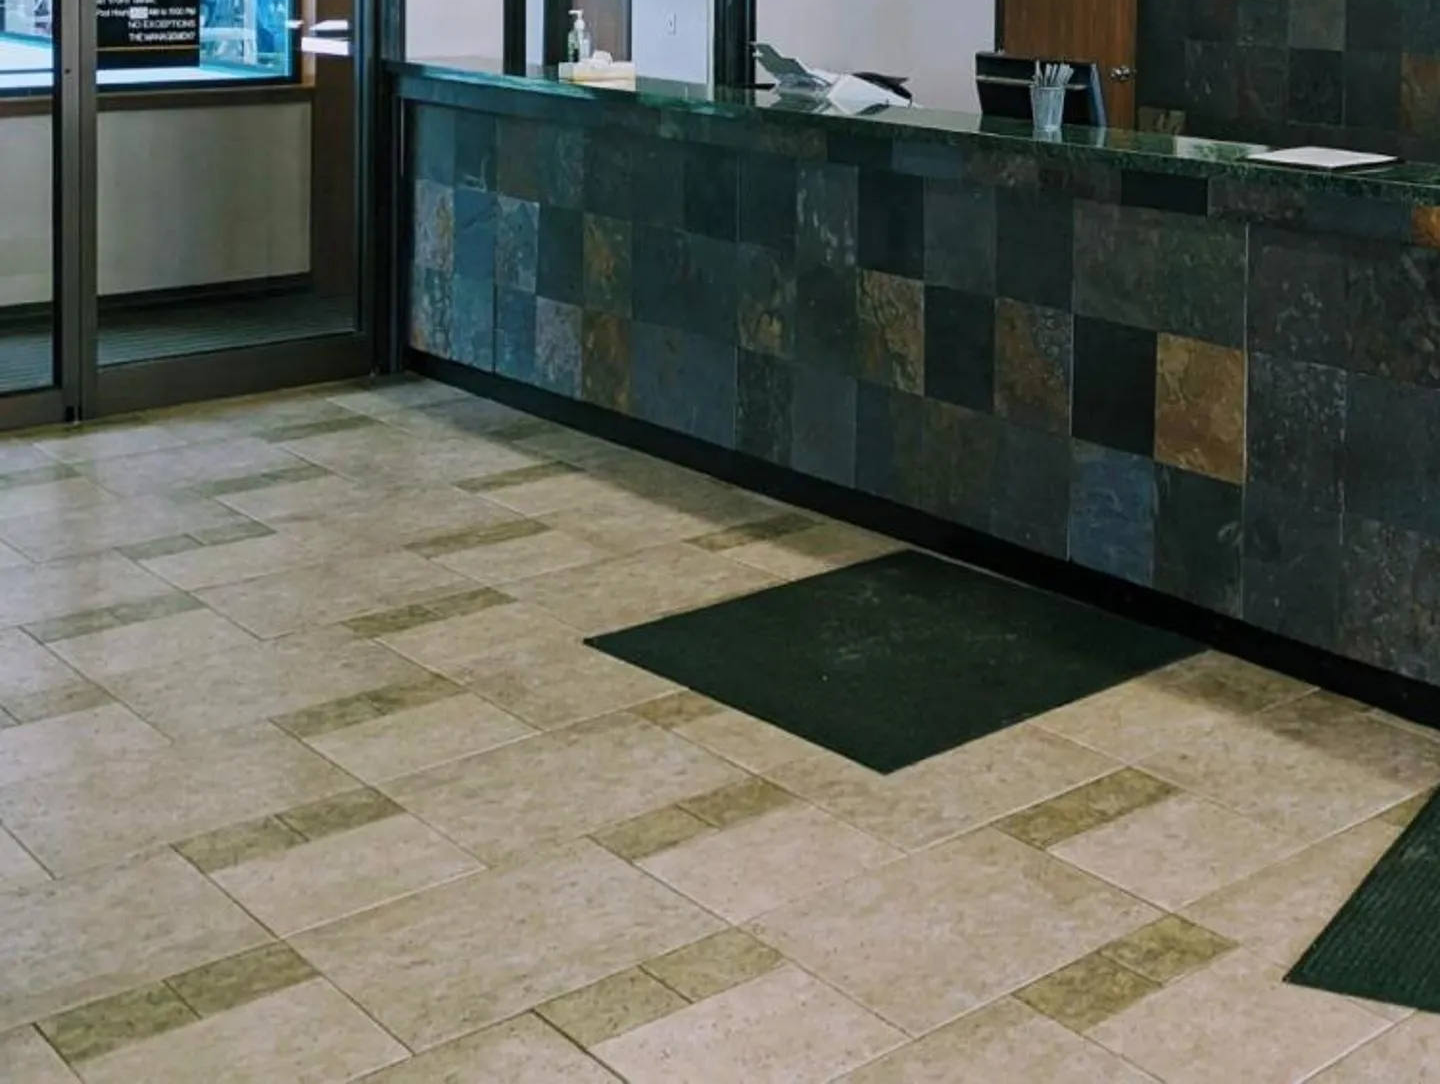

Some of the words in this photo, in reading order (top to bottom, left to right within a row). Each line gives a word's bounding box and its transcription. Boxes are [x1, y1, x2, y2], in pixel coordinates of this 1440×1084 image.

[128, 19, 142, 28] NO
[143, 18, 196, 29] EXCEPTIONS
[144, 30, 196, 41] MANAGEMENT
